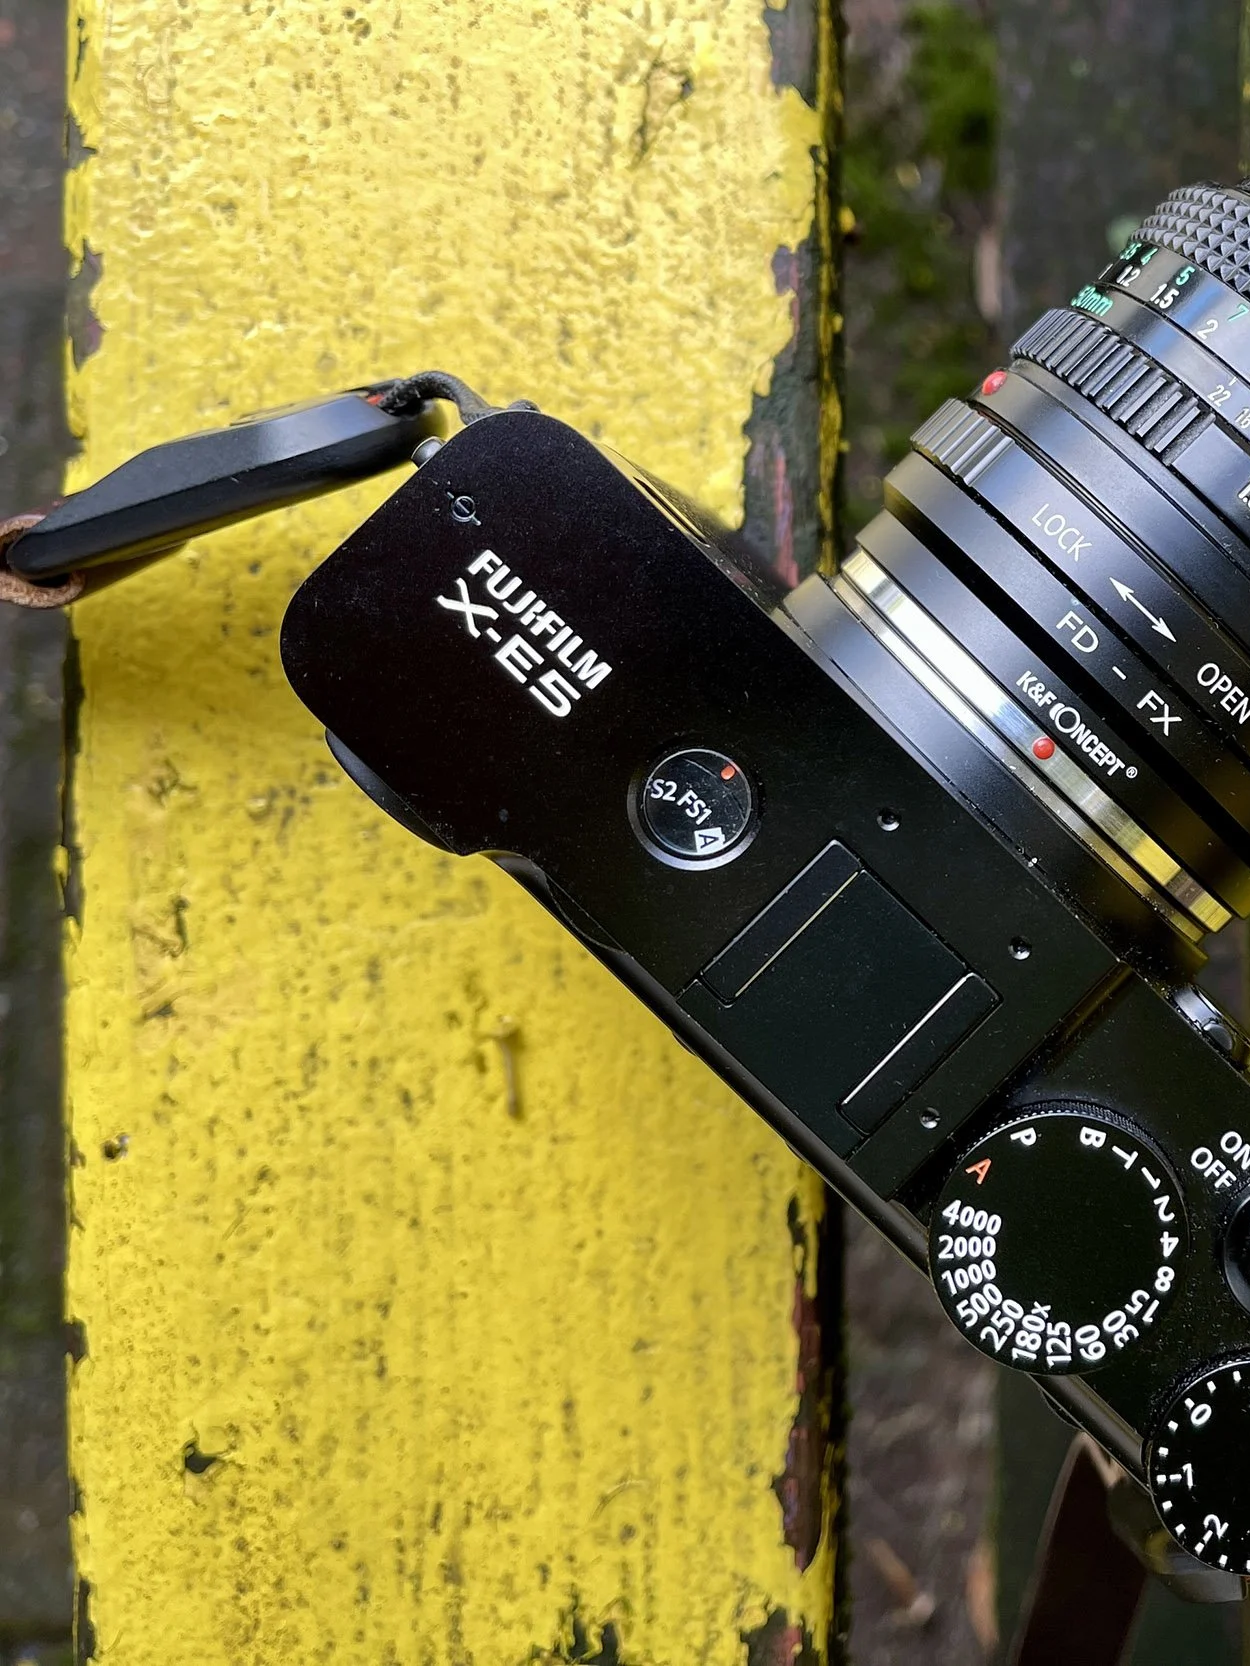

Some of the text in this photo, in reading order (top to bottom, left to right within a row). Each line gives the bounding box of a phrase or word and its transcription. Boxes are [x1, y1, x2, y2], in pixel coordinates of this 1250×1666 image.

[1116, 265, 1141, 287] 1.2
[1150, 283, 1180, 309] 1.5
[1196, 319, 1219, 340] 2
[1175, 266, 1196, 286] 5
[1227, 303, 1250, 323] 7
[1207, 384, 1232, 407] 22
[1031, 503, 1092, 562] LOCK
[467, 549, 613, 690] FUJIFILM
[436, 577, 582, 717] X-E5
[1056, 610, 1099, 653] FD
[1136, 690, 1182, 736] FX
[650, 779, 712, 825] S2 FS1
[698, 834, 720, 848] A
[1010, 1127, 1037, 1147] P
[1079, 1126, 1107, 1149] B
[965, 1158, 992, 1185] A
[1112, 1145, 1138, 1170] T
[1190, 1147, 1236, 1188] OFF
[1141, 1166, 1160, 1190] 1
[942, 1200, 1002, 1236] 4000
[1153, 1195, 1175, 1222] 2
[938, 1235, 996, 1259] 2000
[1160, 1231, 1179, 1258] 4
[941, 1259, 997, 1296] 1000
[1154, 1266, 1175, 1292] 8
[956, 1283, 1003, 1329] 500
[1125, 1289, 1160, 1323] 15
[980, 1299, 1024, 1353] 250
[1074, 1324, 1106, 1361] 60
[1102, 1310, 1139, 1348] 30
[1046, 1321, 1072, 1368] 125
[1190, 1403, 1212, 1426] 0
